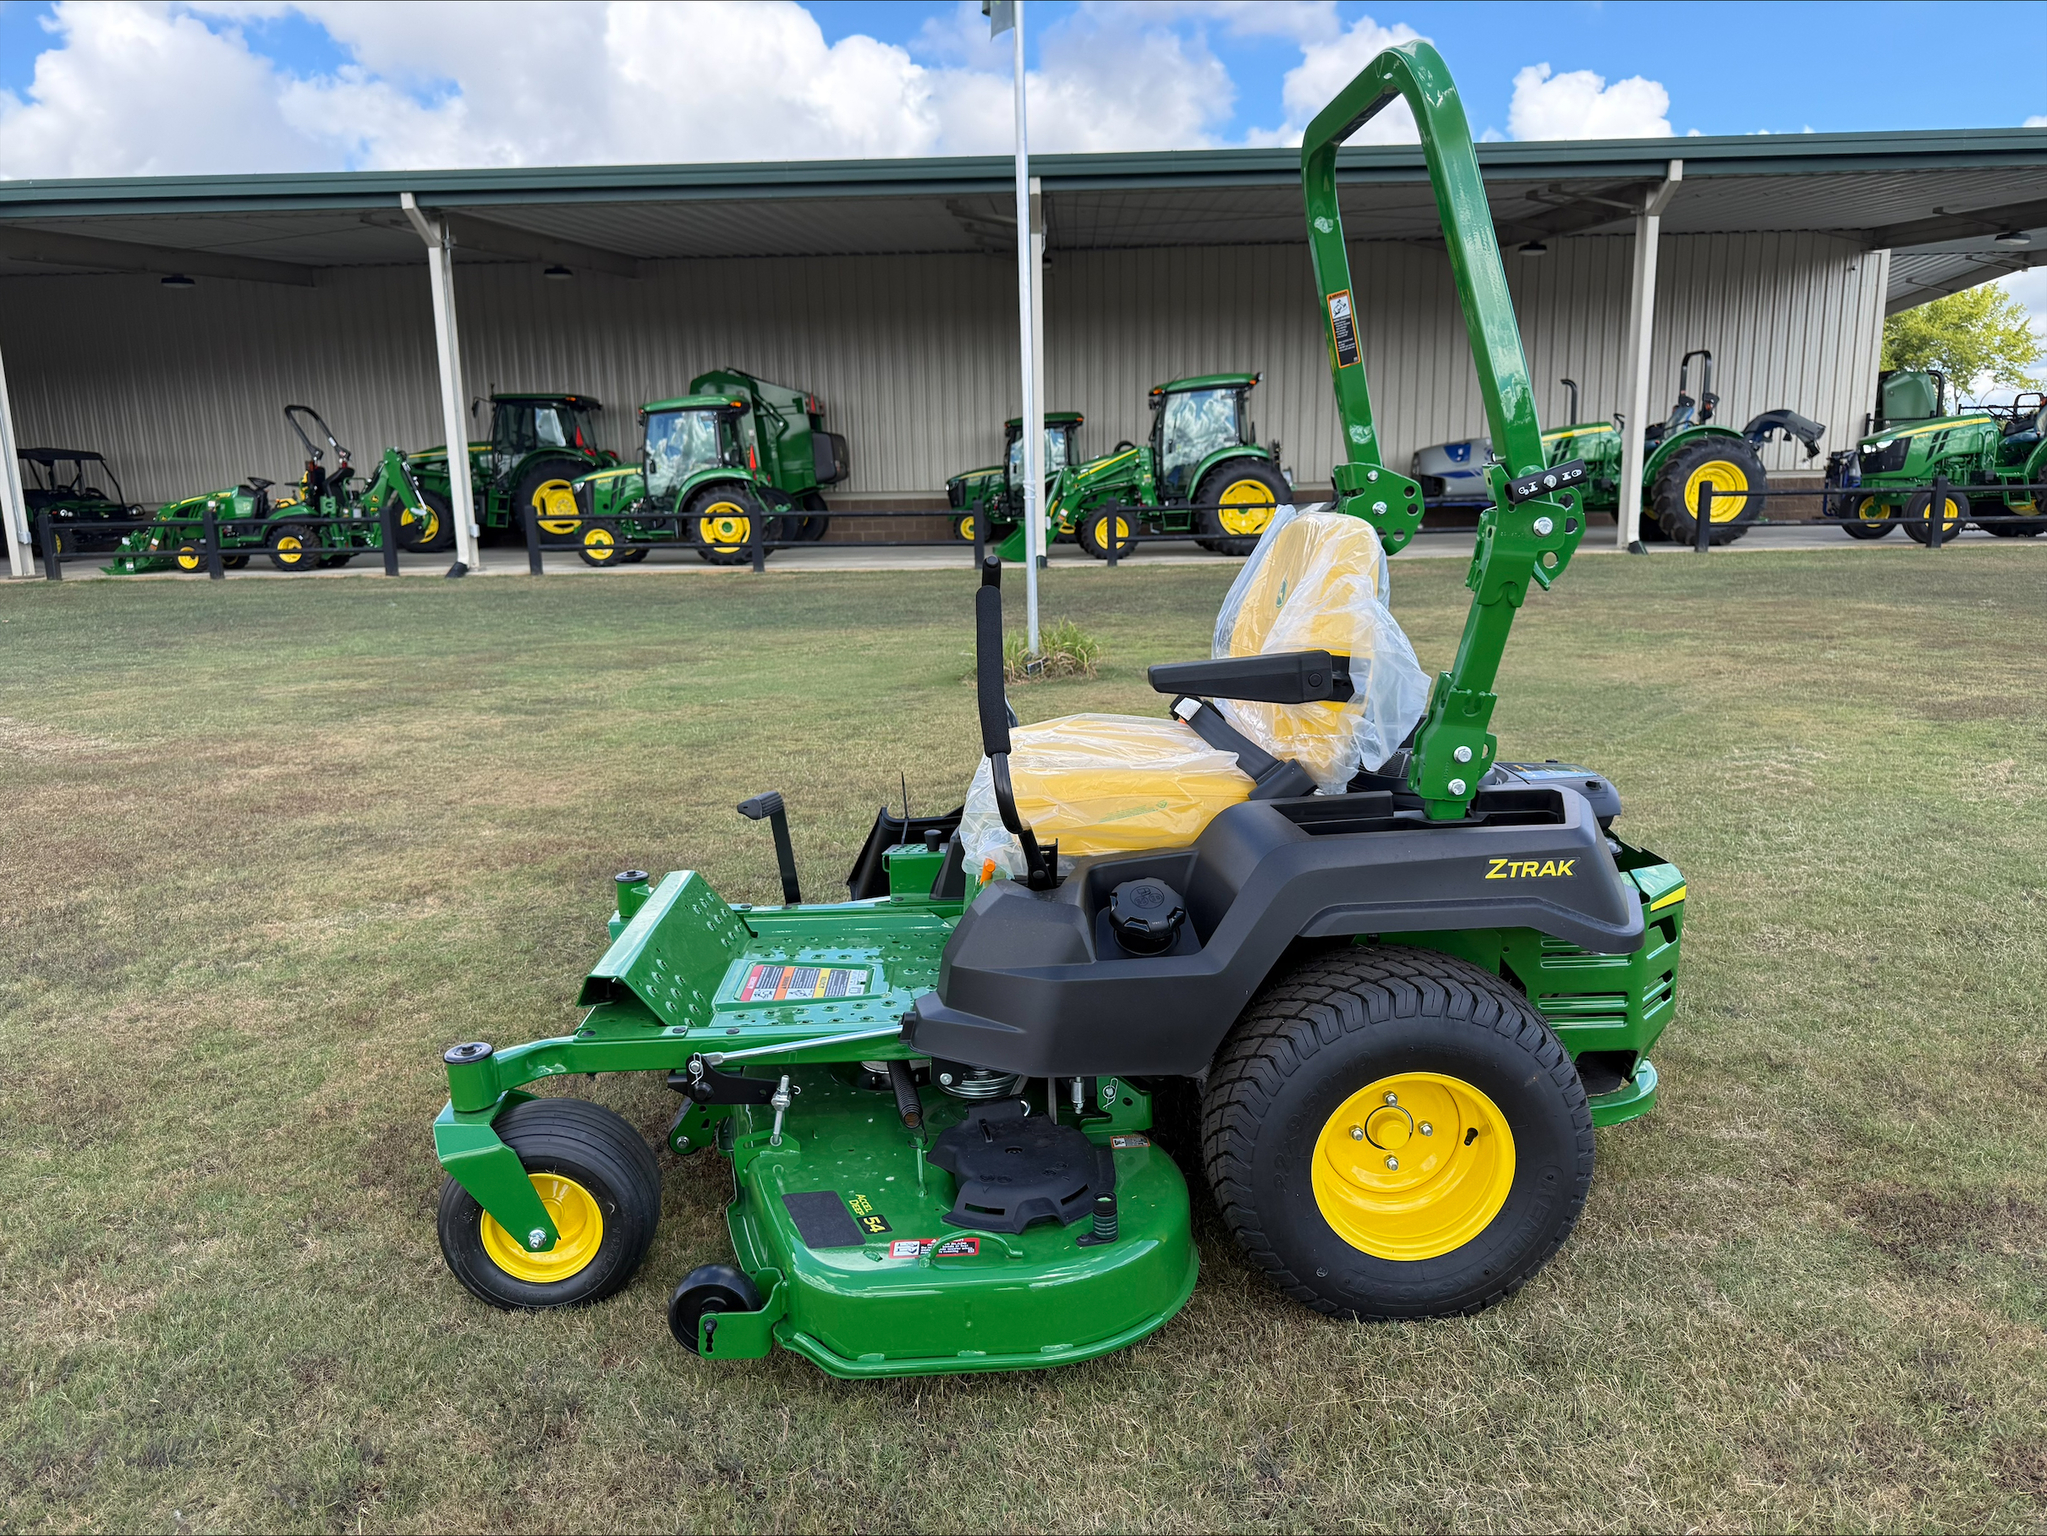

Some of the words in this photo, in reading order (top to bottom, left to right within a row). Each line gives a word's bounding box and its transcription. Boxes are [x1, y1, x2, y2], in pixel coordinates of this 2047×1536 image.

[1485, 858, 1576, 880] ZTRAK
[848, 1199, 866, 1216] DEEP
[855, 1194, 873, 1213] ACCEL
[863, 1216, 886, 1233] 54
[1484, 1177, 1558, 1274] KENDA
